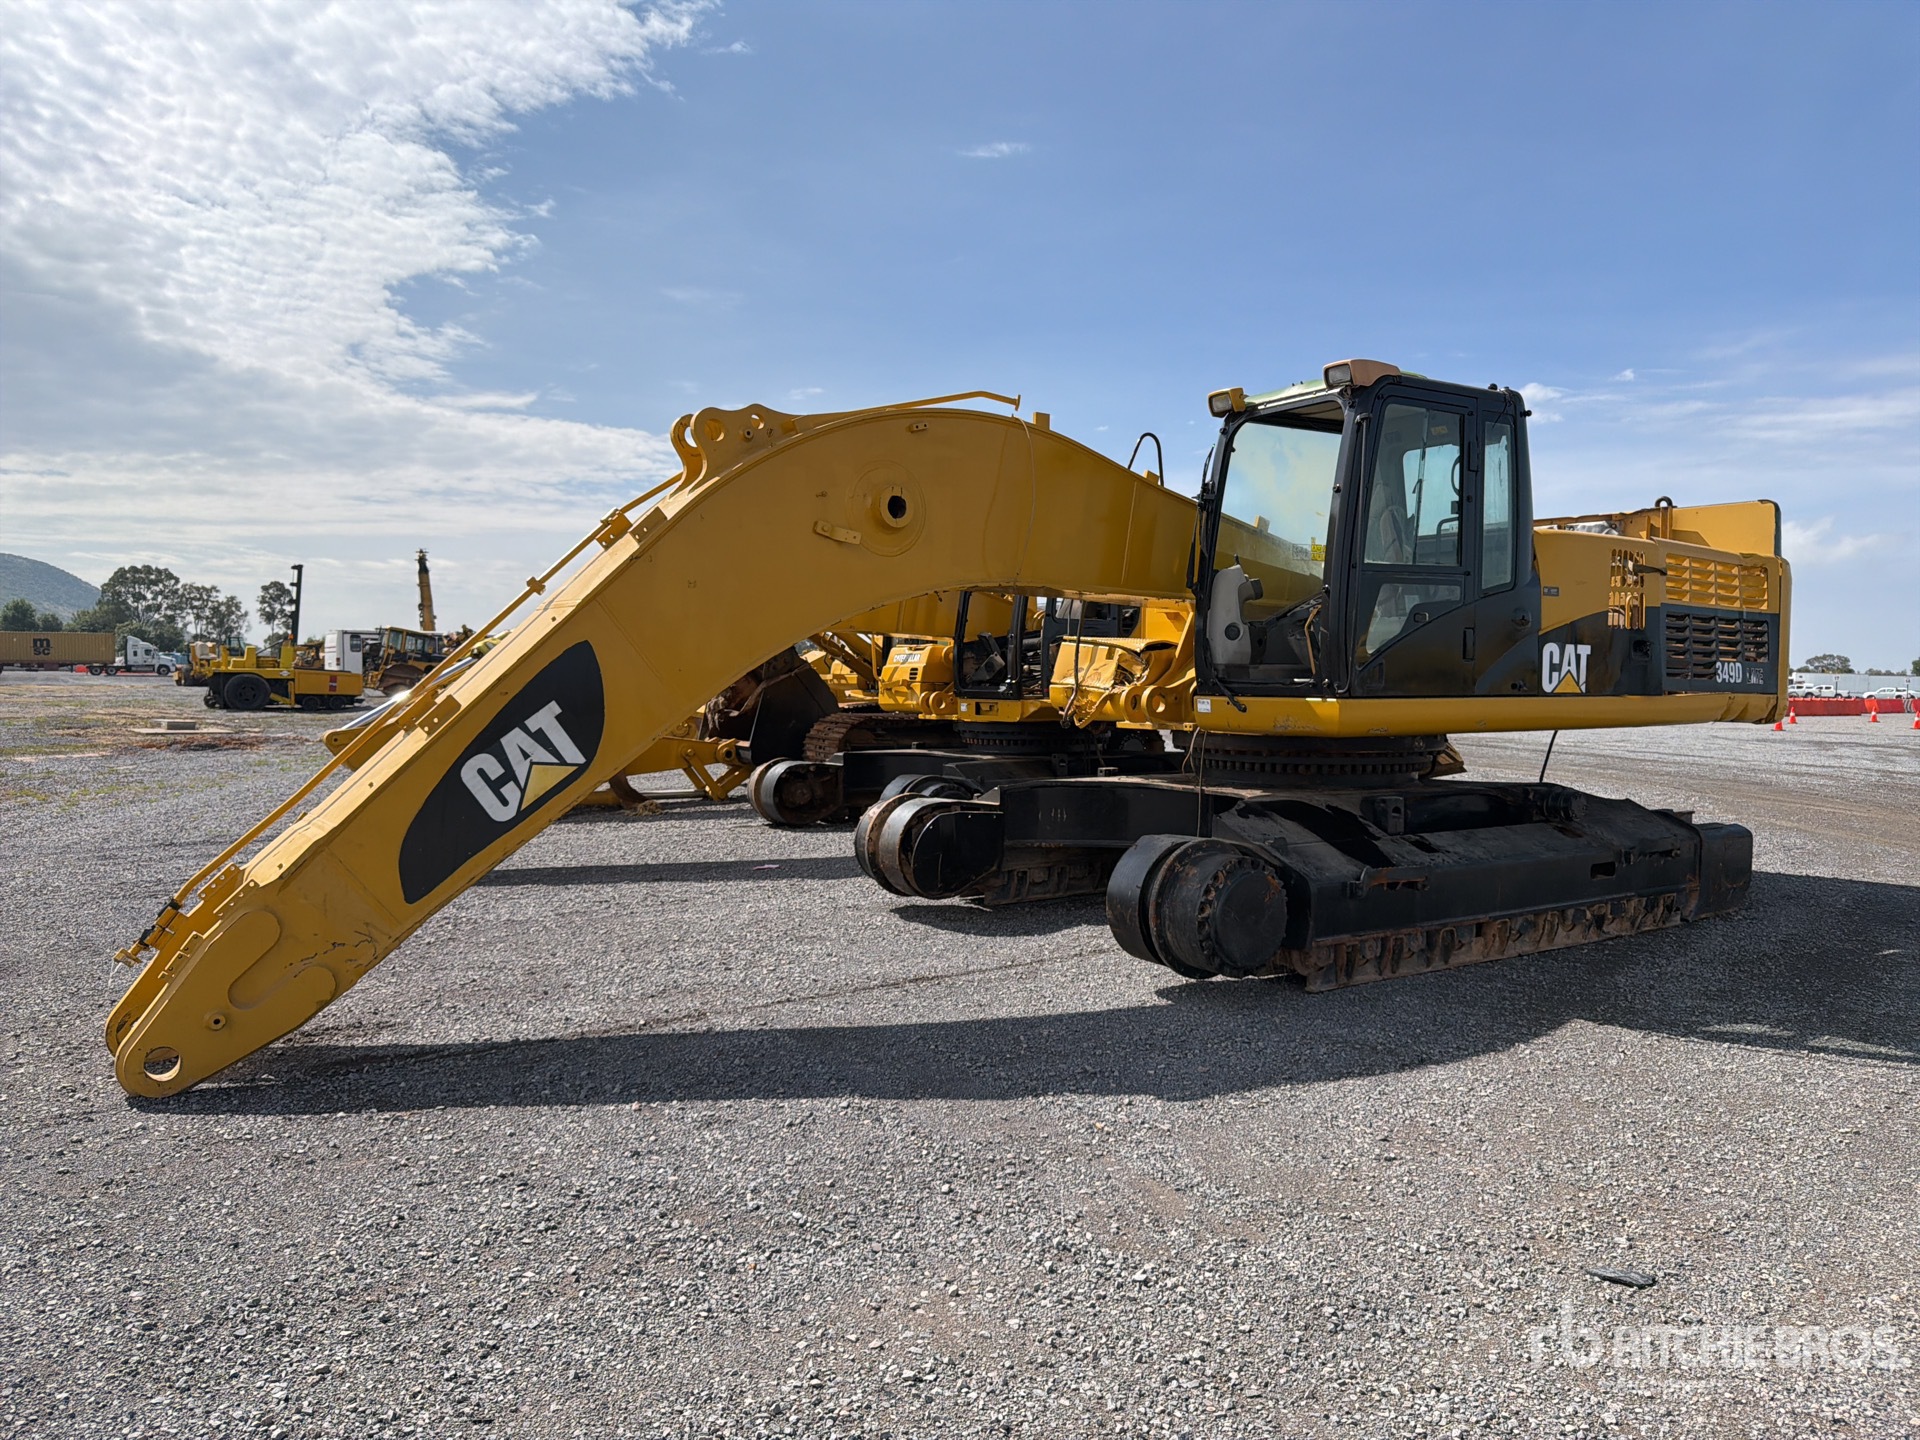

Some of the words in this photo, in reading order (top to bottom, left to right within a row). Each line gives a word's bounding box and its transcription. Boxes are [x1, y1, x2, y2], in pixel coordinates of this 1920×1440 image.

[1541, 642, 1591, 693] CAT
[1715, 661, 1743, 683] 349D
[460, 699, 587, 822] CAT
